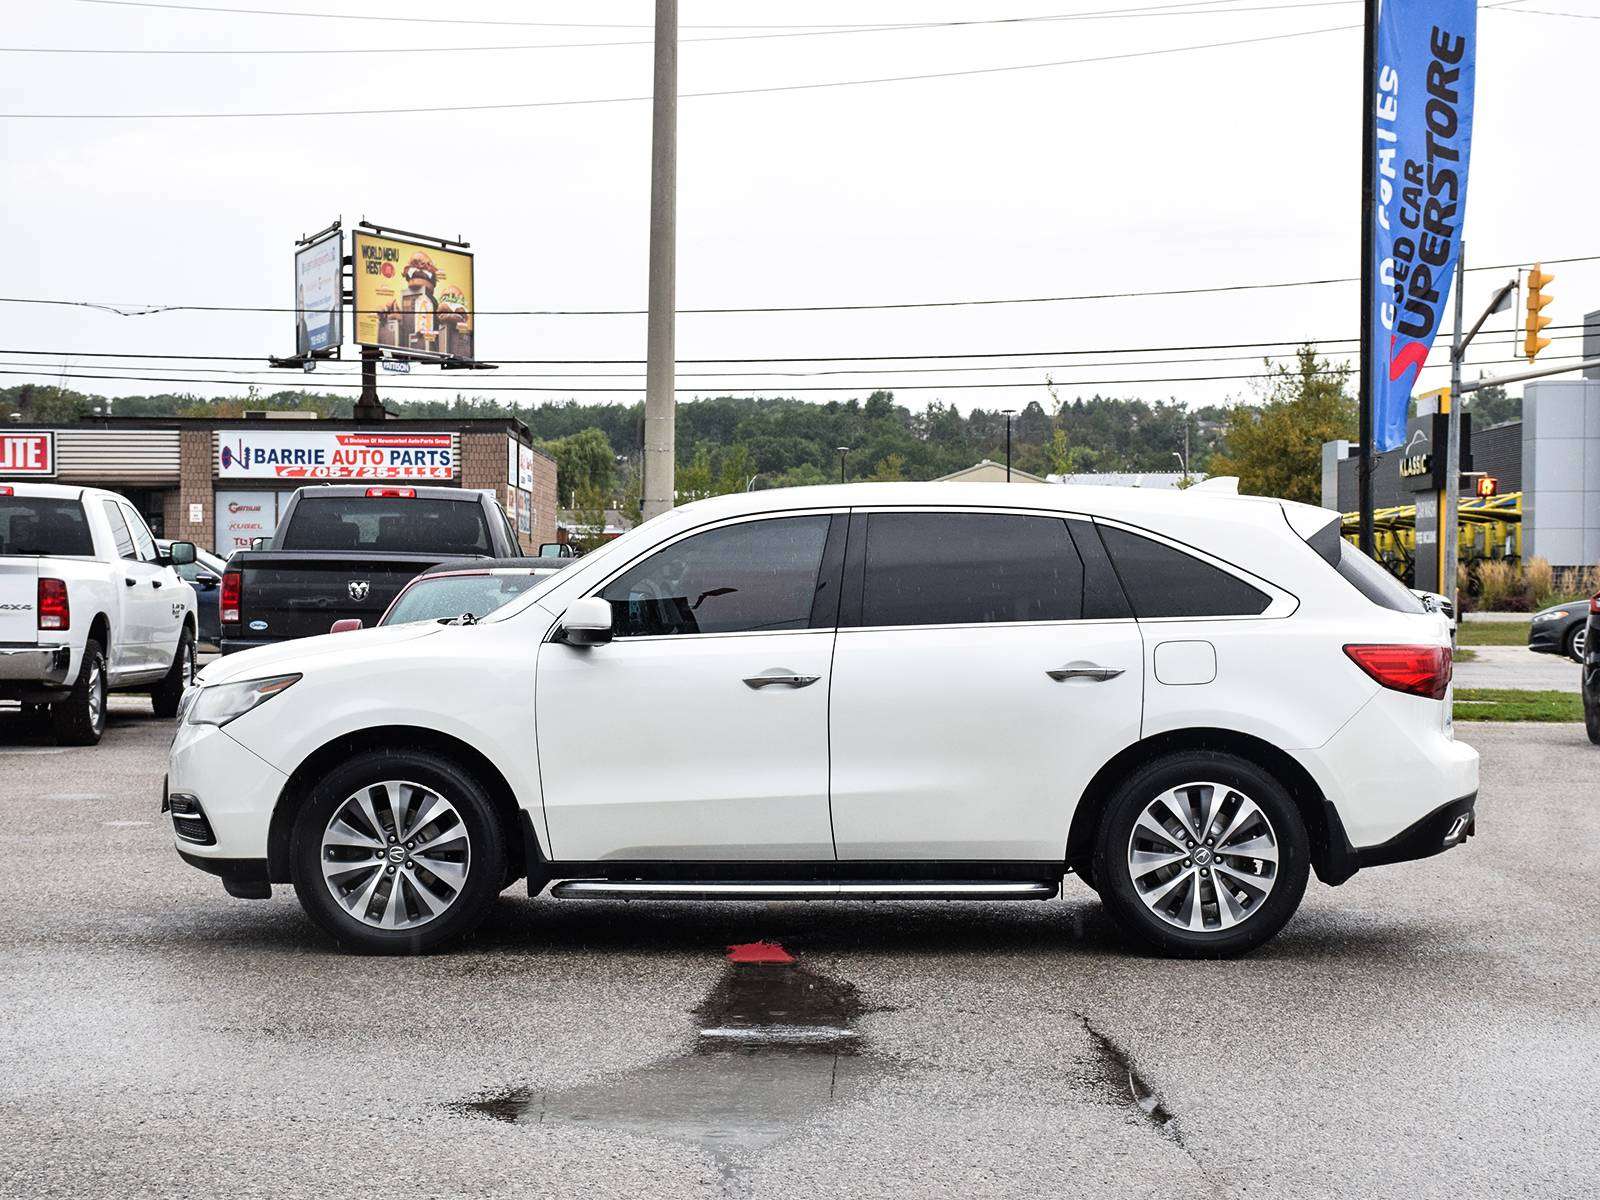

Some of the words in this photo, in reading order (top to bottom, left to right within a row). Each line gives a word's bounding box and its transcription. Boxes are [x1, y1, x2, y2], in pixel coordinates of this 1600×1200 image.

[1400, 158, 1425, 230] CAR
[361, 244, 383, 260] WORLD
[383, 247, 400, 262] MENU
[366, 260, 382, 275] HEIST
[254, 447, 325, 465] BARRIE
[331, 449, 385, 466] AUTO
[390, 450, 451, 467] PARTS
[304, 466, 446, 478] 705-725-1114
